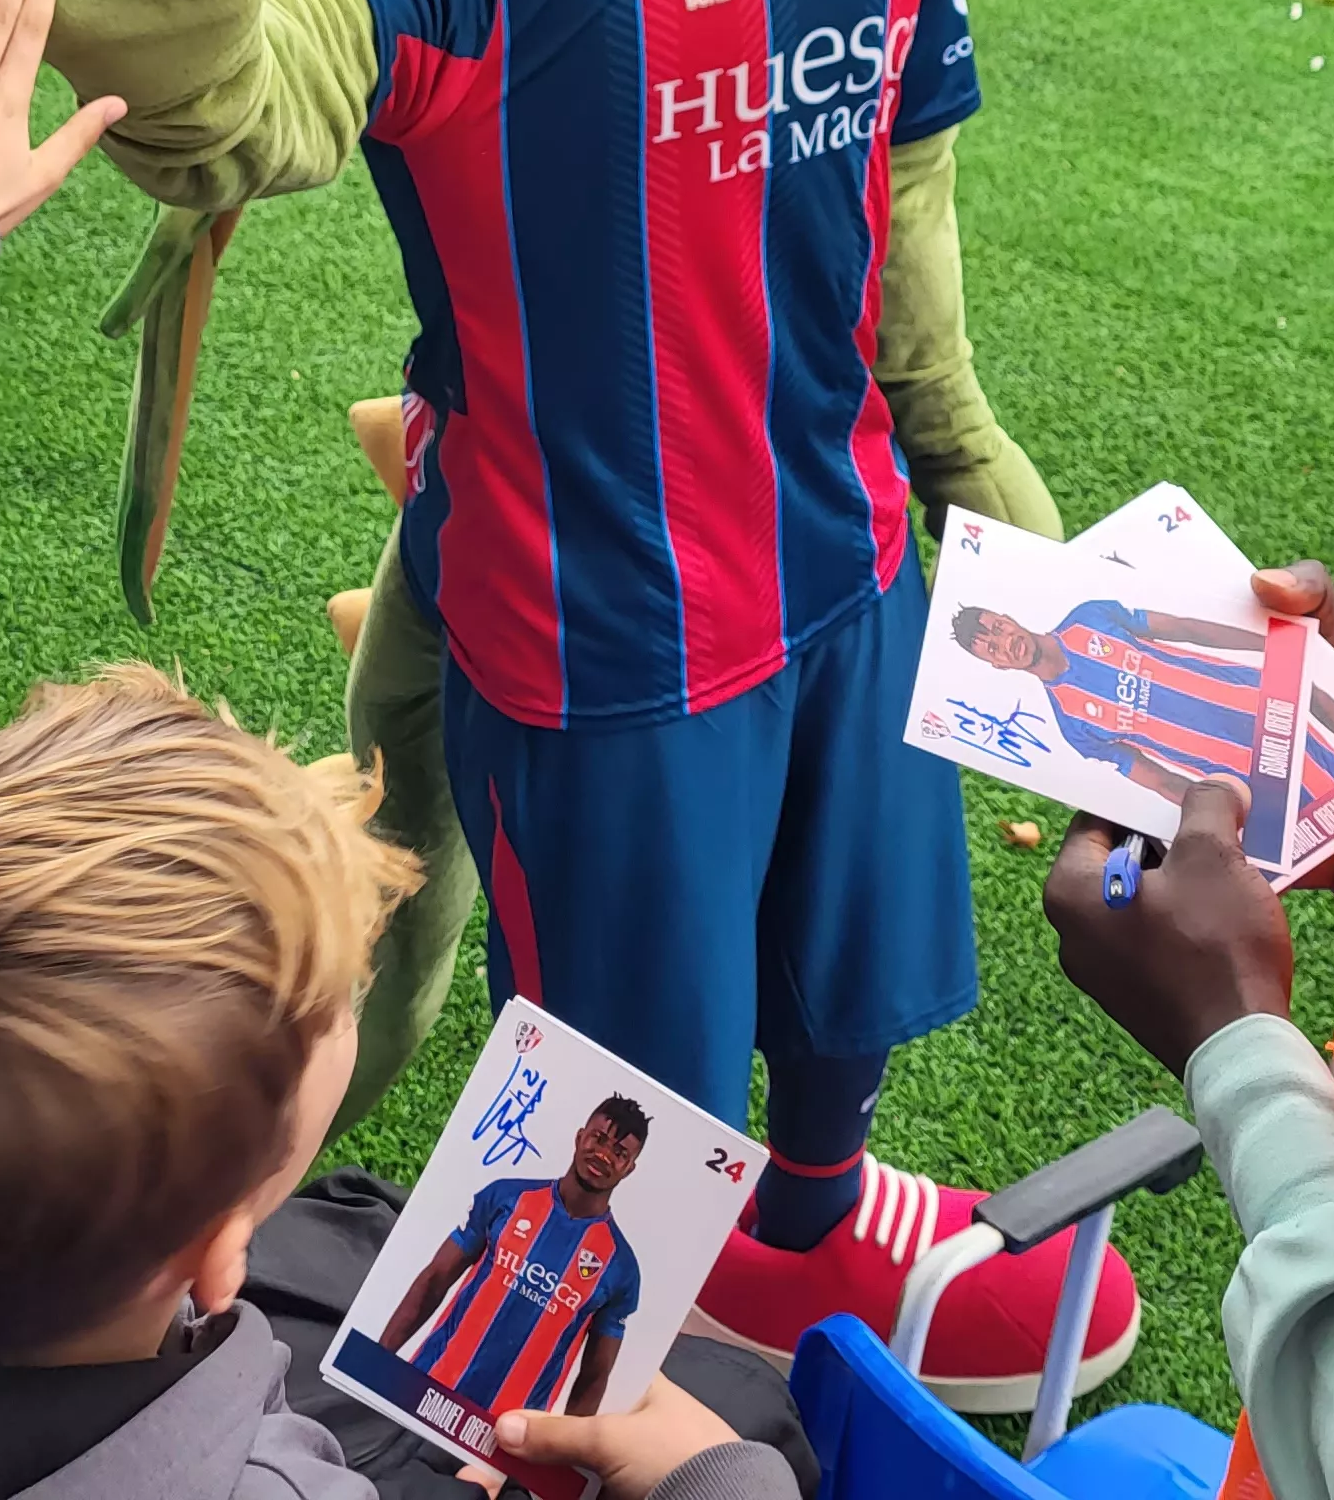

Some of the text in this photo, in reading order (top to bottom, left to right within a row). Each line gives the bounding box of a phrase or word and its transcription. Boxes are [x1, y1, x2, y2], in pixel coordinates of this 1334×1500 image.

[1158, 506, 1192, 533] 24
[961, 522, 984, 556] 24
[705, 1148, 746, 1184] 24
[416, 1387, 499, 1459] SAMUEL OBEN
